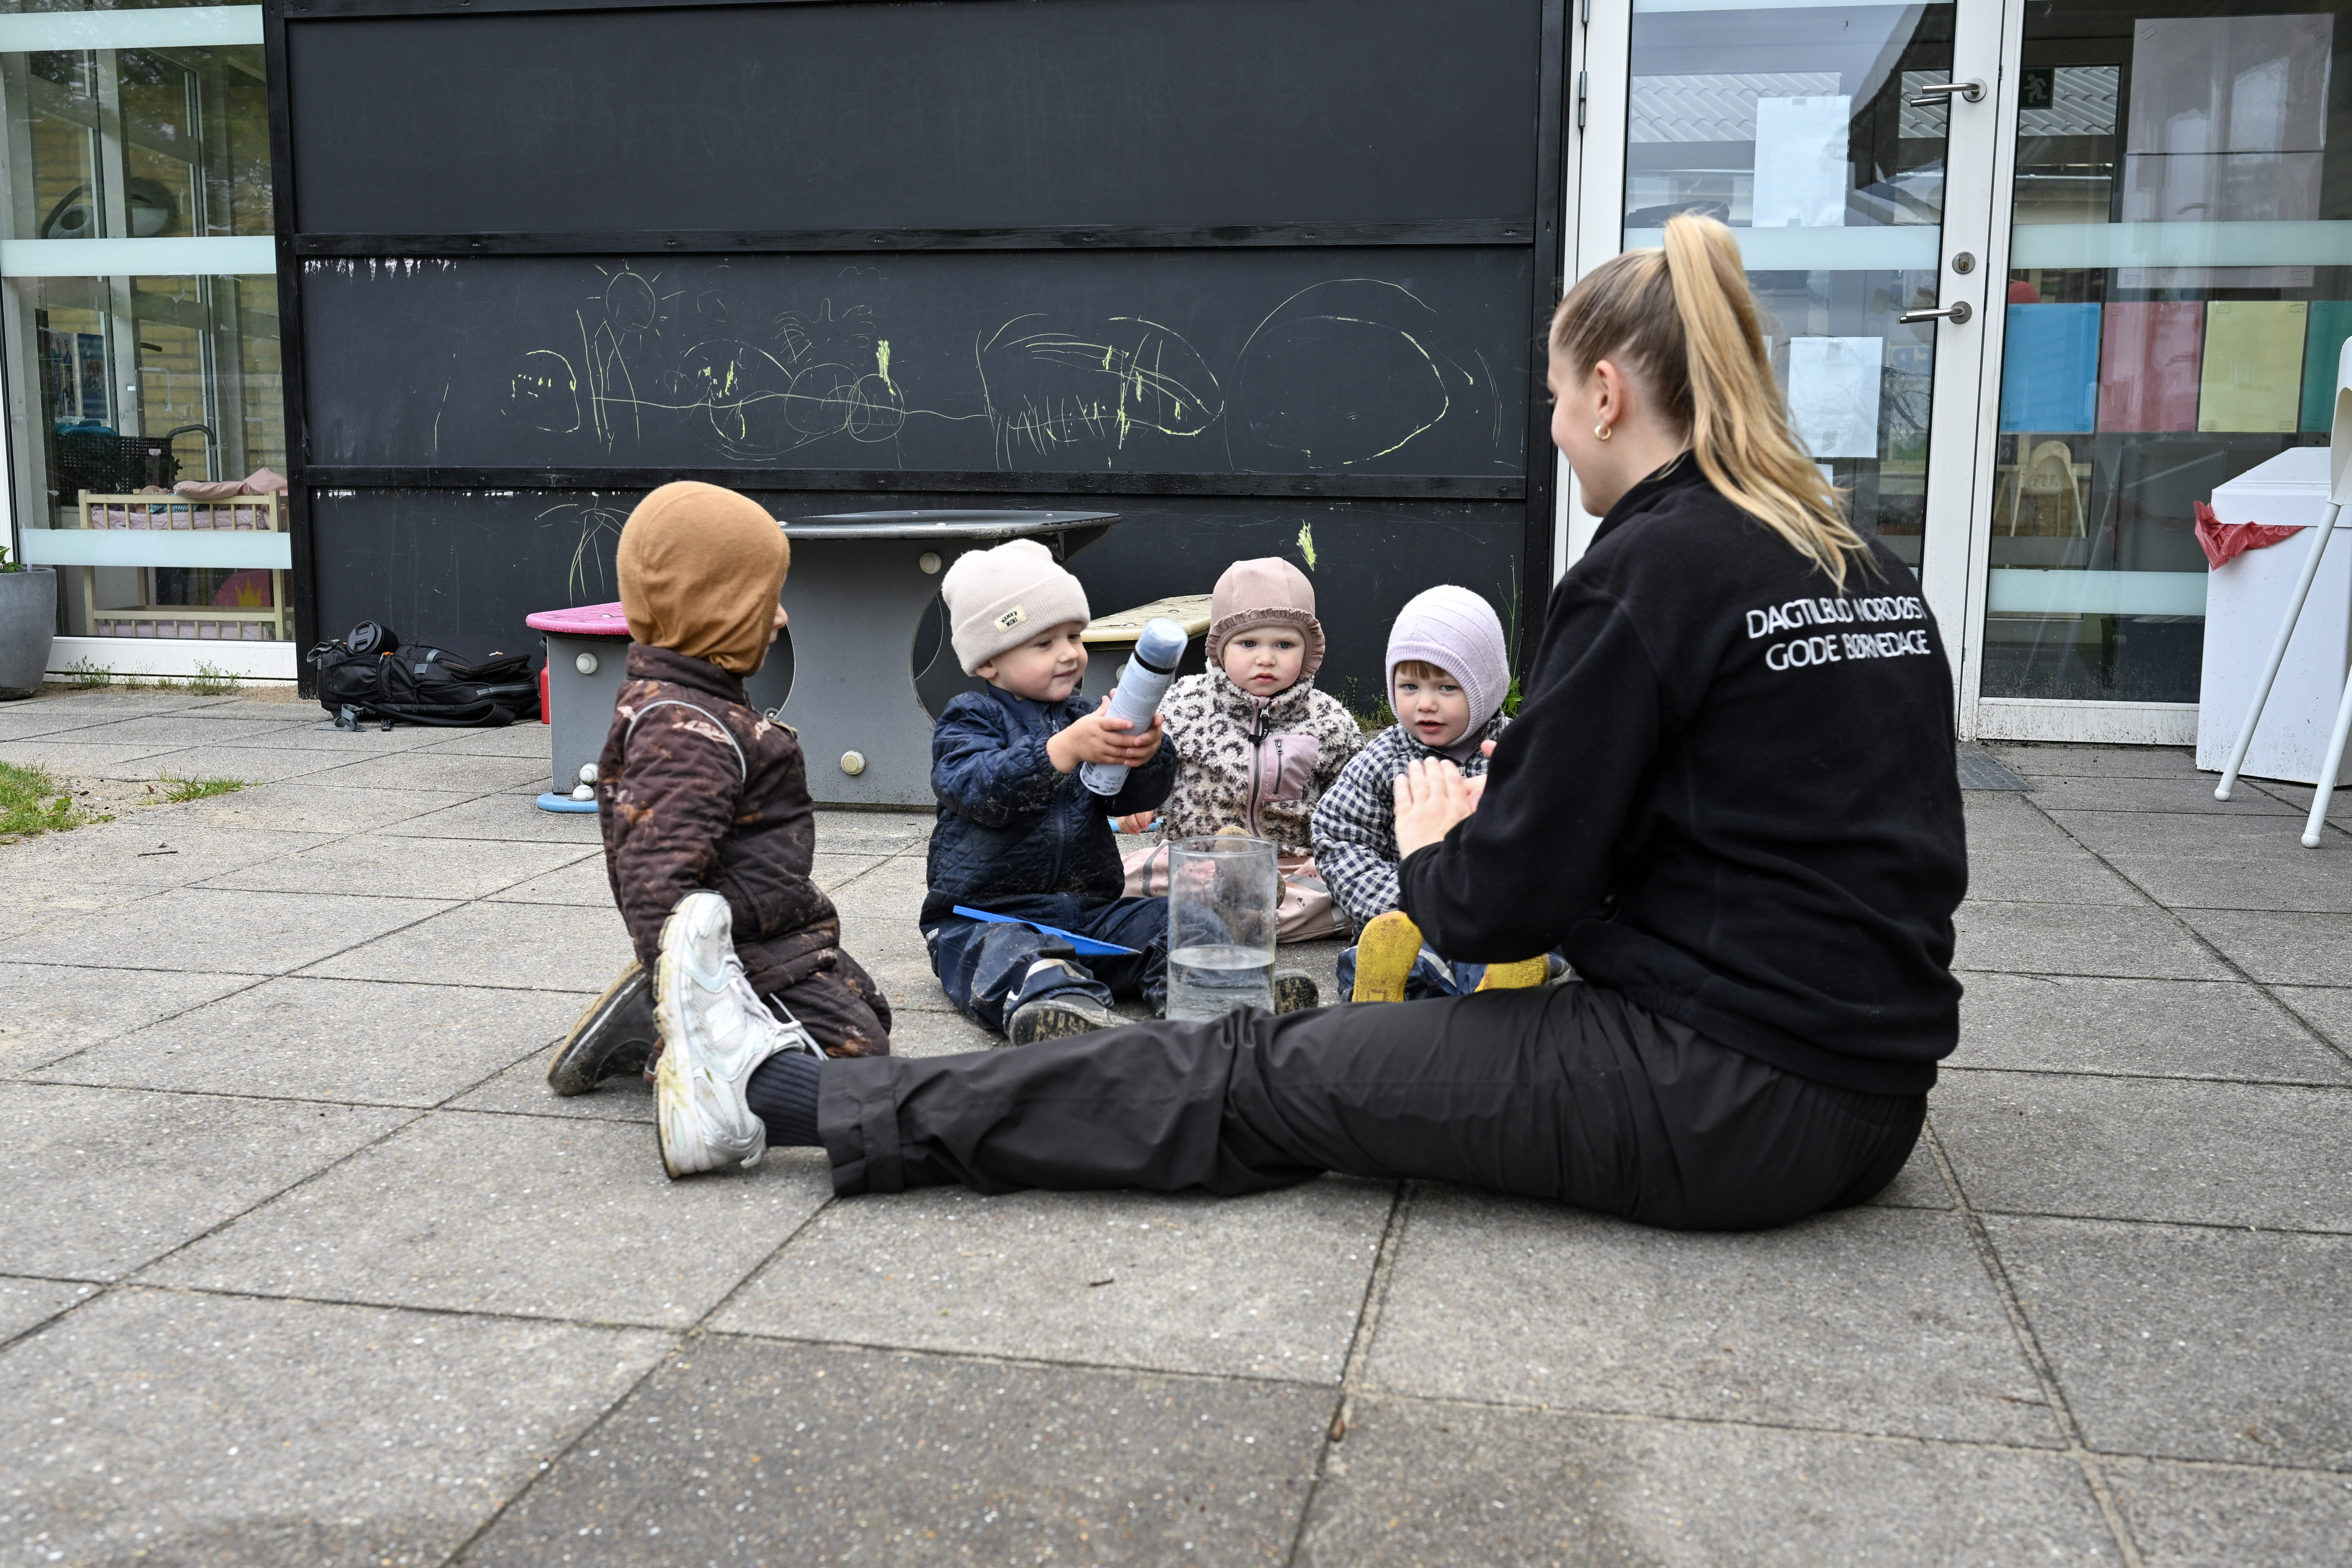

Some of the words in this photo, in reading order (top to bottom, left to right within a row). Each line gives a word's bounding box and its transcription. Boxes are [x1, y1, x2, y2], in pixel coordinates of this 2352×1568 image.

[1001, 611, 1017, 623] MAMA'S
[1006, 617, 1018, 627] MINI
[1746, 597, 1854, 639] DAGTILBUD
[1765, 634, 1842, 670] GODE
